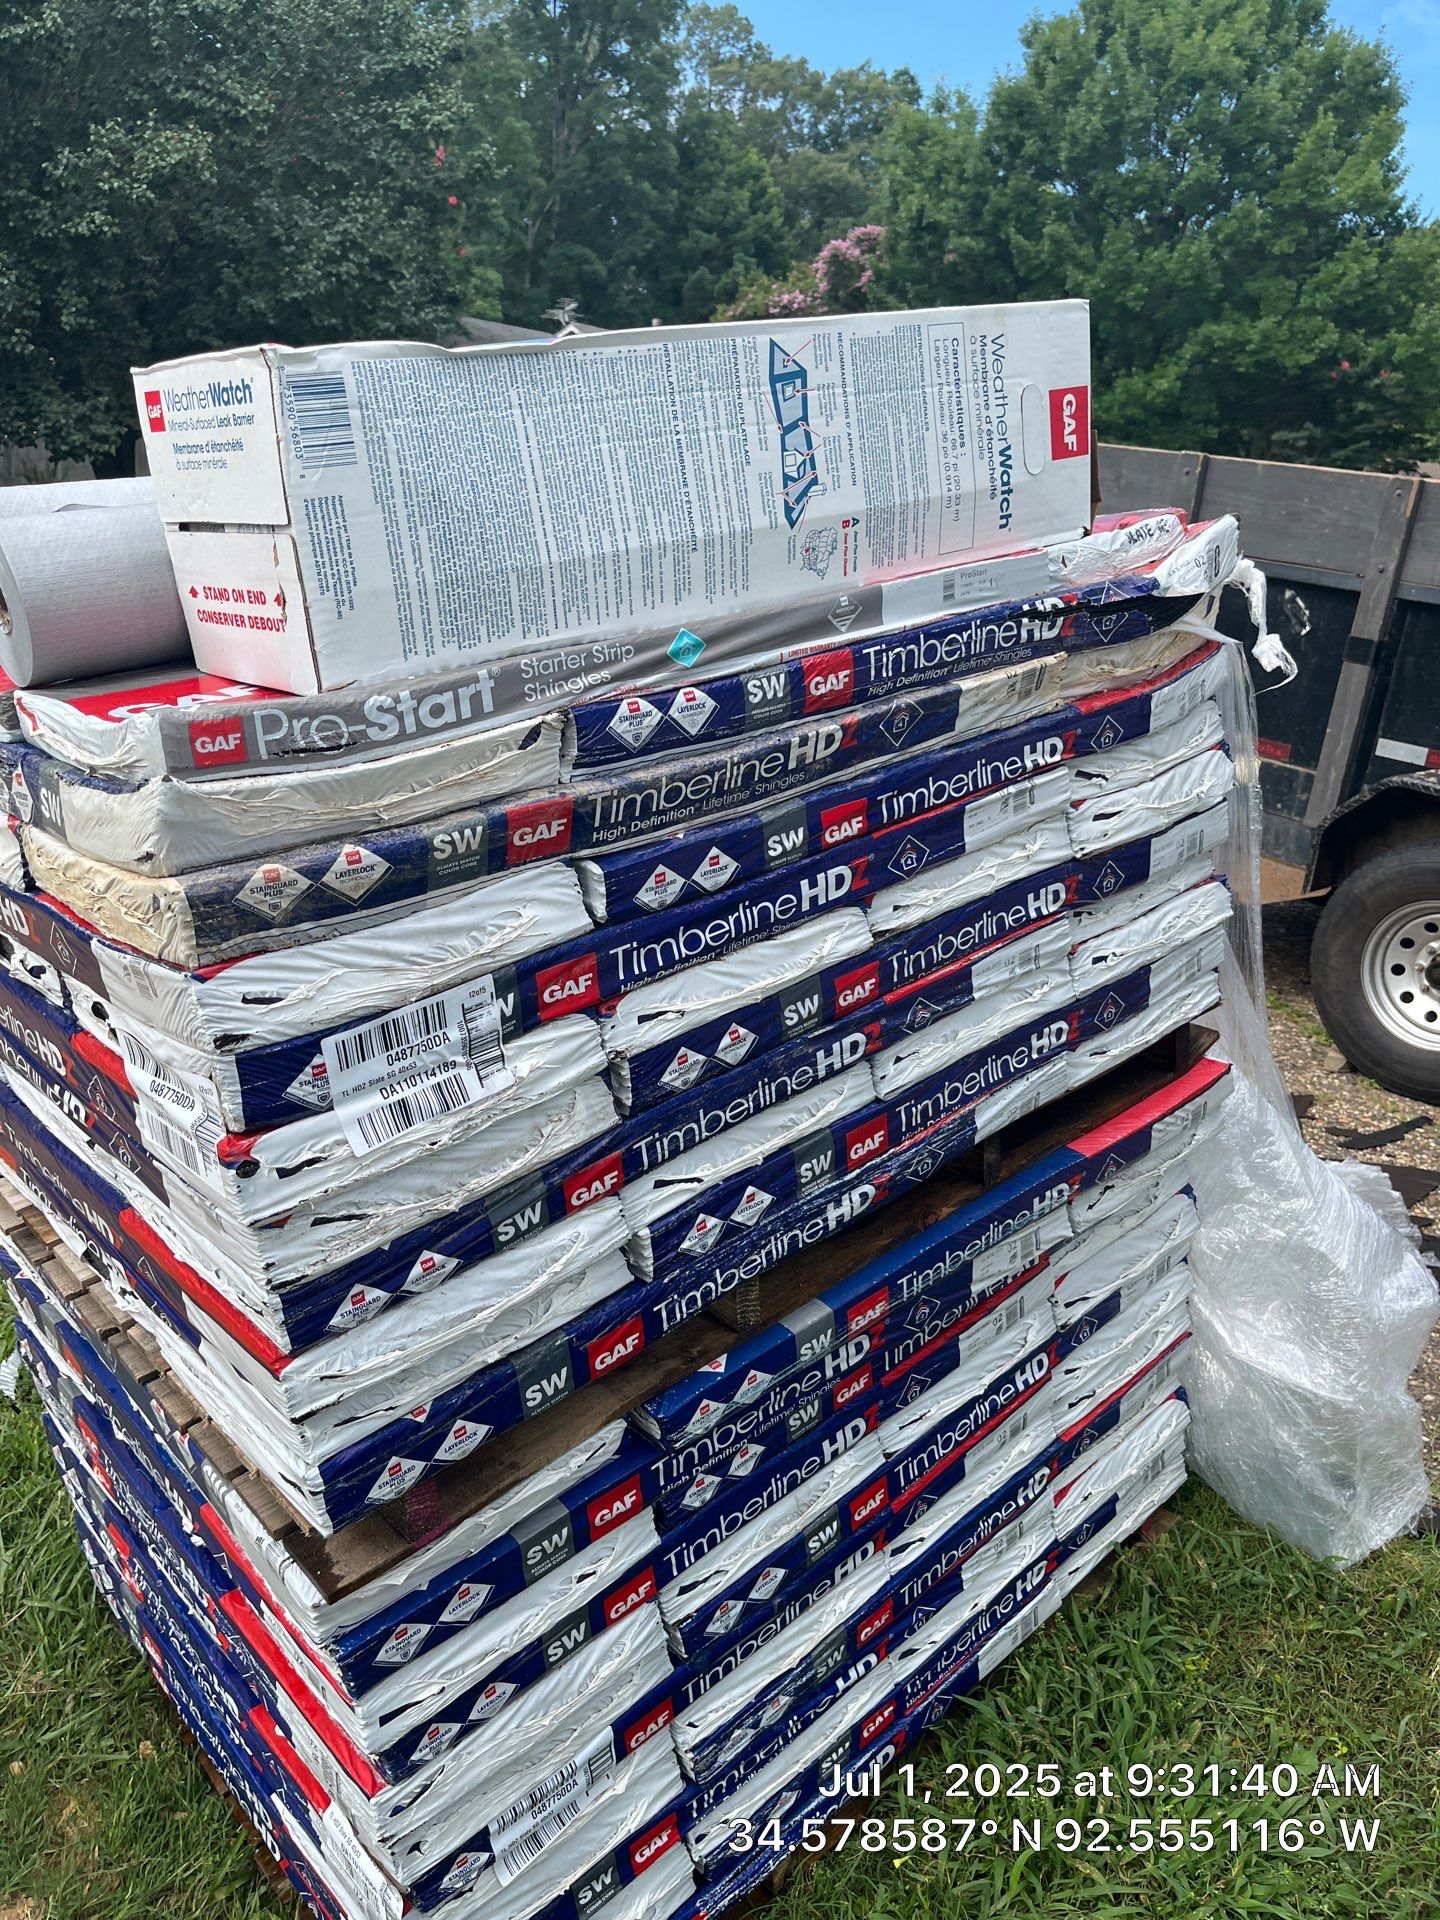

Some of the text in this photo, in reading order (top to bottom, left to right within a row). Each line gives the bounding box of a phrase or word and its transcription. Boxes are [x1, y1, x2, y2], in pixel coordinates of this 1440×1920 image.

[663, 343, 677, 407] INSTALLATION
[934, 340, 942, 384] Largeur
[163, 378, 253, 413] WeatherWatch
[730, 338, 752, 467] PRÉPARATION DU PLATELAGE
[938, 384, 946, 426] Rouleau:
[952, 338, 965, 448] Caractéristiques
[970, 336, 985, 460] à surface minérale
[148, 404, 162, 419] GAF
[168, 412, 254, 432] Mineral-Surfaced Leak Barrier
[284, 386, 296, 421] 73590
[290, 426, 304, 460] 56803
[672, 410, 678, 422] DE
[838, 332, 851, 421] RECOMMANDATIONS
[846, 431, 857, 487] APPLICATION
[979, 335, 998, 500] Membrane d'étanchéité
[1062, 393, 1077, 452] GAF
[674, 424, 680, 437] LA
[942, 338, 951, 389] Longueur
[947, 391, 956, 436] Rouleau:
[952, 514, 960, 522] m)
[942, 430, 948, 444] 36
[991, 333, 1013, 530] WeatherWatch
[172, 438, 244, 456] Membrane d'étanchéité
[942, 448, 948, 460] po
[182, 458, 202, 470] surface
[202, 457, 228, 470] minérale
[676, 439, 689, 489] MEMBRANE
[945, 498, 953, 510] m)
[960, 568, 989, 580] ProStart
[203, 586, 267, 606] STAND ON END
[197, 608, 287, 633] CONSERVER DEBOUT
[520, 643, 635, 680] Starter Strip
[868, 646, 1032, 697] High Definition Shingles
[524, 670, 612, 702] Shingles
[748, 672, 786, 704] SW
[809, 670, 850, 696] GAF
[618, 710, 653, 724] STAINGUARD
[677, 702, 707, 714] LAYERLOCK
[195, 732, 241, 755] GAF
[592, 770, 805, 843] High Definition Lifetime Shingles
[433, 826, 483, 861] SW
[512, 818, 567, 846] GAF
[768, 826, 804, 858] SW
[824, 816, 863, 844] GAF
[334, 863, 377, 880] LAYERLOCK
[436, 854, 481, 872] ALWAYS MATCH
[438, 861, 478, 876] COLOR CODE
[700, 864, 729, 879] LAYERLOCK
[250, 878, 299, 897] STAINGUARD
[264, 888, 284, 899] PLUS
[644, 878, 677, 893] STAINGUARD
[542, 972, 593, 1004] GAF
[838, 978, 876, 1007] GAF
[783, 994, 819, 1026] SW
[386, 1034, 451, 1067] 0487750DA
[150, 1080, 196, 1112] 0487750DA
[341, 1090, 351, 1098] TL
[368, 1076, 385, 1090] Slate
[386, 1071, 397, 1081] SG
[398, 1062, 417, 1074] 40x53
[379, 1060, 457, 1101] DA110114189
[850, 1130, 885, 1160] GAF
[800, 1150, 833, 1184] SW
[570, 1170, 618, 1207] GAF
[498, 1200, 543, 1243] SW
[411, 1263, 448, 1286] LAYERLOCK
[340, 1294, 381, 1319] STAINGUARD
[850, 1300, 887, 1331] GAF
[594, 1332, 640, 1370] GAF
[800, 1328, 832, 1362] SW
[525, 1367, 568, 1408] SW
[836, 1372, 871, 1403] GAF
[789, 1400, 820, 1432] SW
[444, 1430, 478, 1454] LAYERLOCK
[378, 1464, 416, 1490] STAINGUARD
[594, 1489, 637, 1528] GAF
[854, 1492, 885, 1522] GAF
[526, 1526, 568, 1566] SW
[807, 1520, 838, 1554] SW
[610, 1580, 652, 1620] GAF
[754, 1574, 779, 1596] LAYERLOCK
[448, 1590, 481, 1616] LAYERLOCK
[384, 1628, 422, 1655] STAINGUARD
[548, 1621, 586, 1663] SW
[860, 1610, 891, 1642] GAF
[816, 1644, 845, 1679] SW
[476, 1690, 508, 1715] LAYERLOCK
[630, 1710, 670, 1749] GAF
[862, 1704, 895, 1739] GAF
[418, 1726, 453, 1753] STAINGUARD
[531, 1778, 579, 1821] 0487750DA
[634, 1826, 674, 1864] GAF
[578, 1865, 615, 1905] SW
